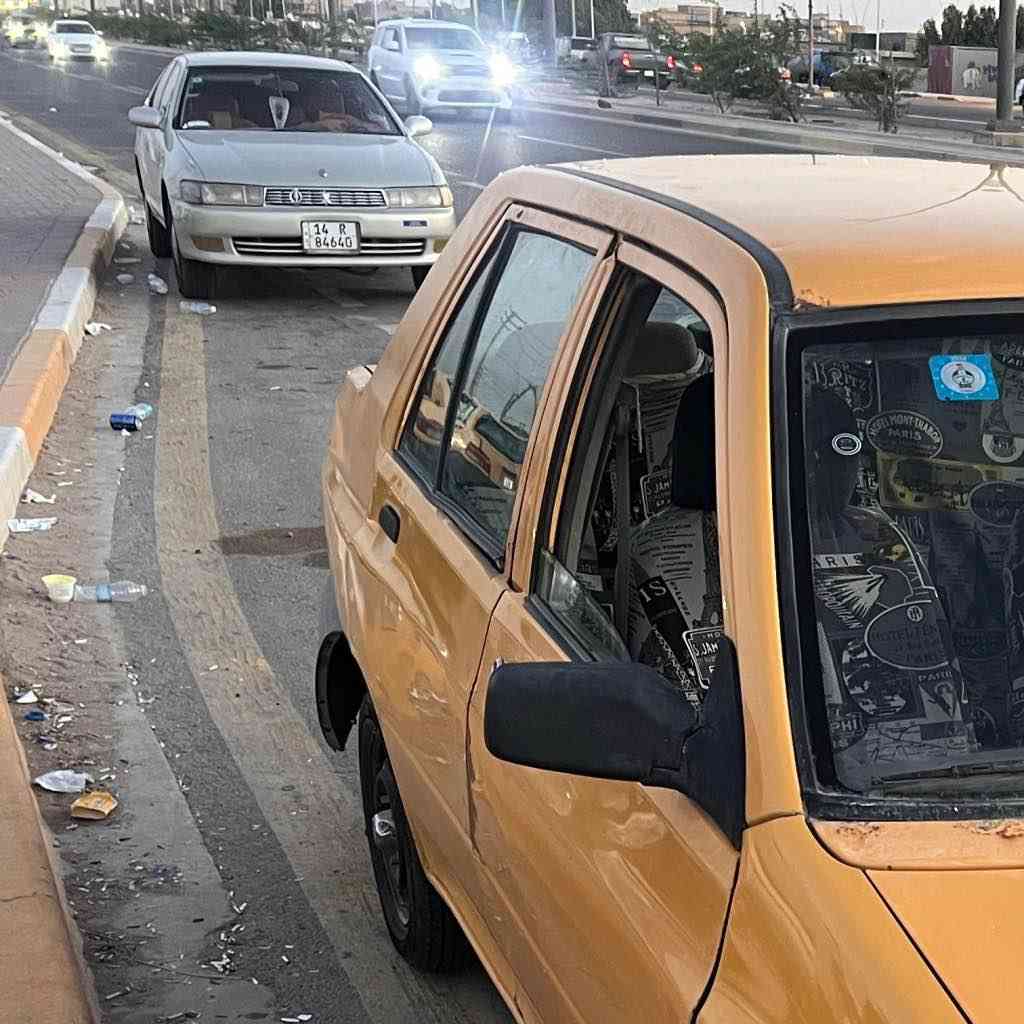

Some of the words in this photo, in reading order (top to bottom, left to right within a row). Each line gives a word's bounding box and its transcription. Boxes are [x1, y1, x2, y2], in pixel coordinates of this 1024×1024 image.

[314, 224, 329, 236] 14
[339, 224, 347, 235] R
[315, 236, 353, 248] 84640
